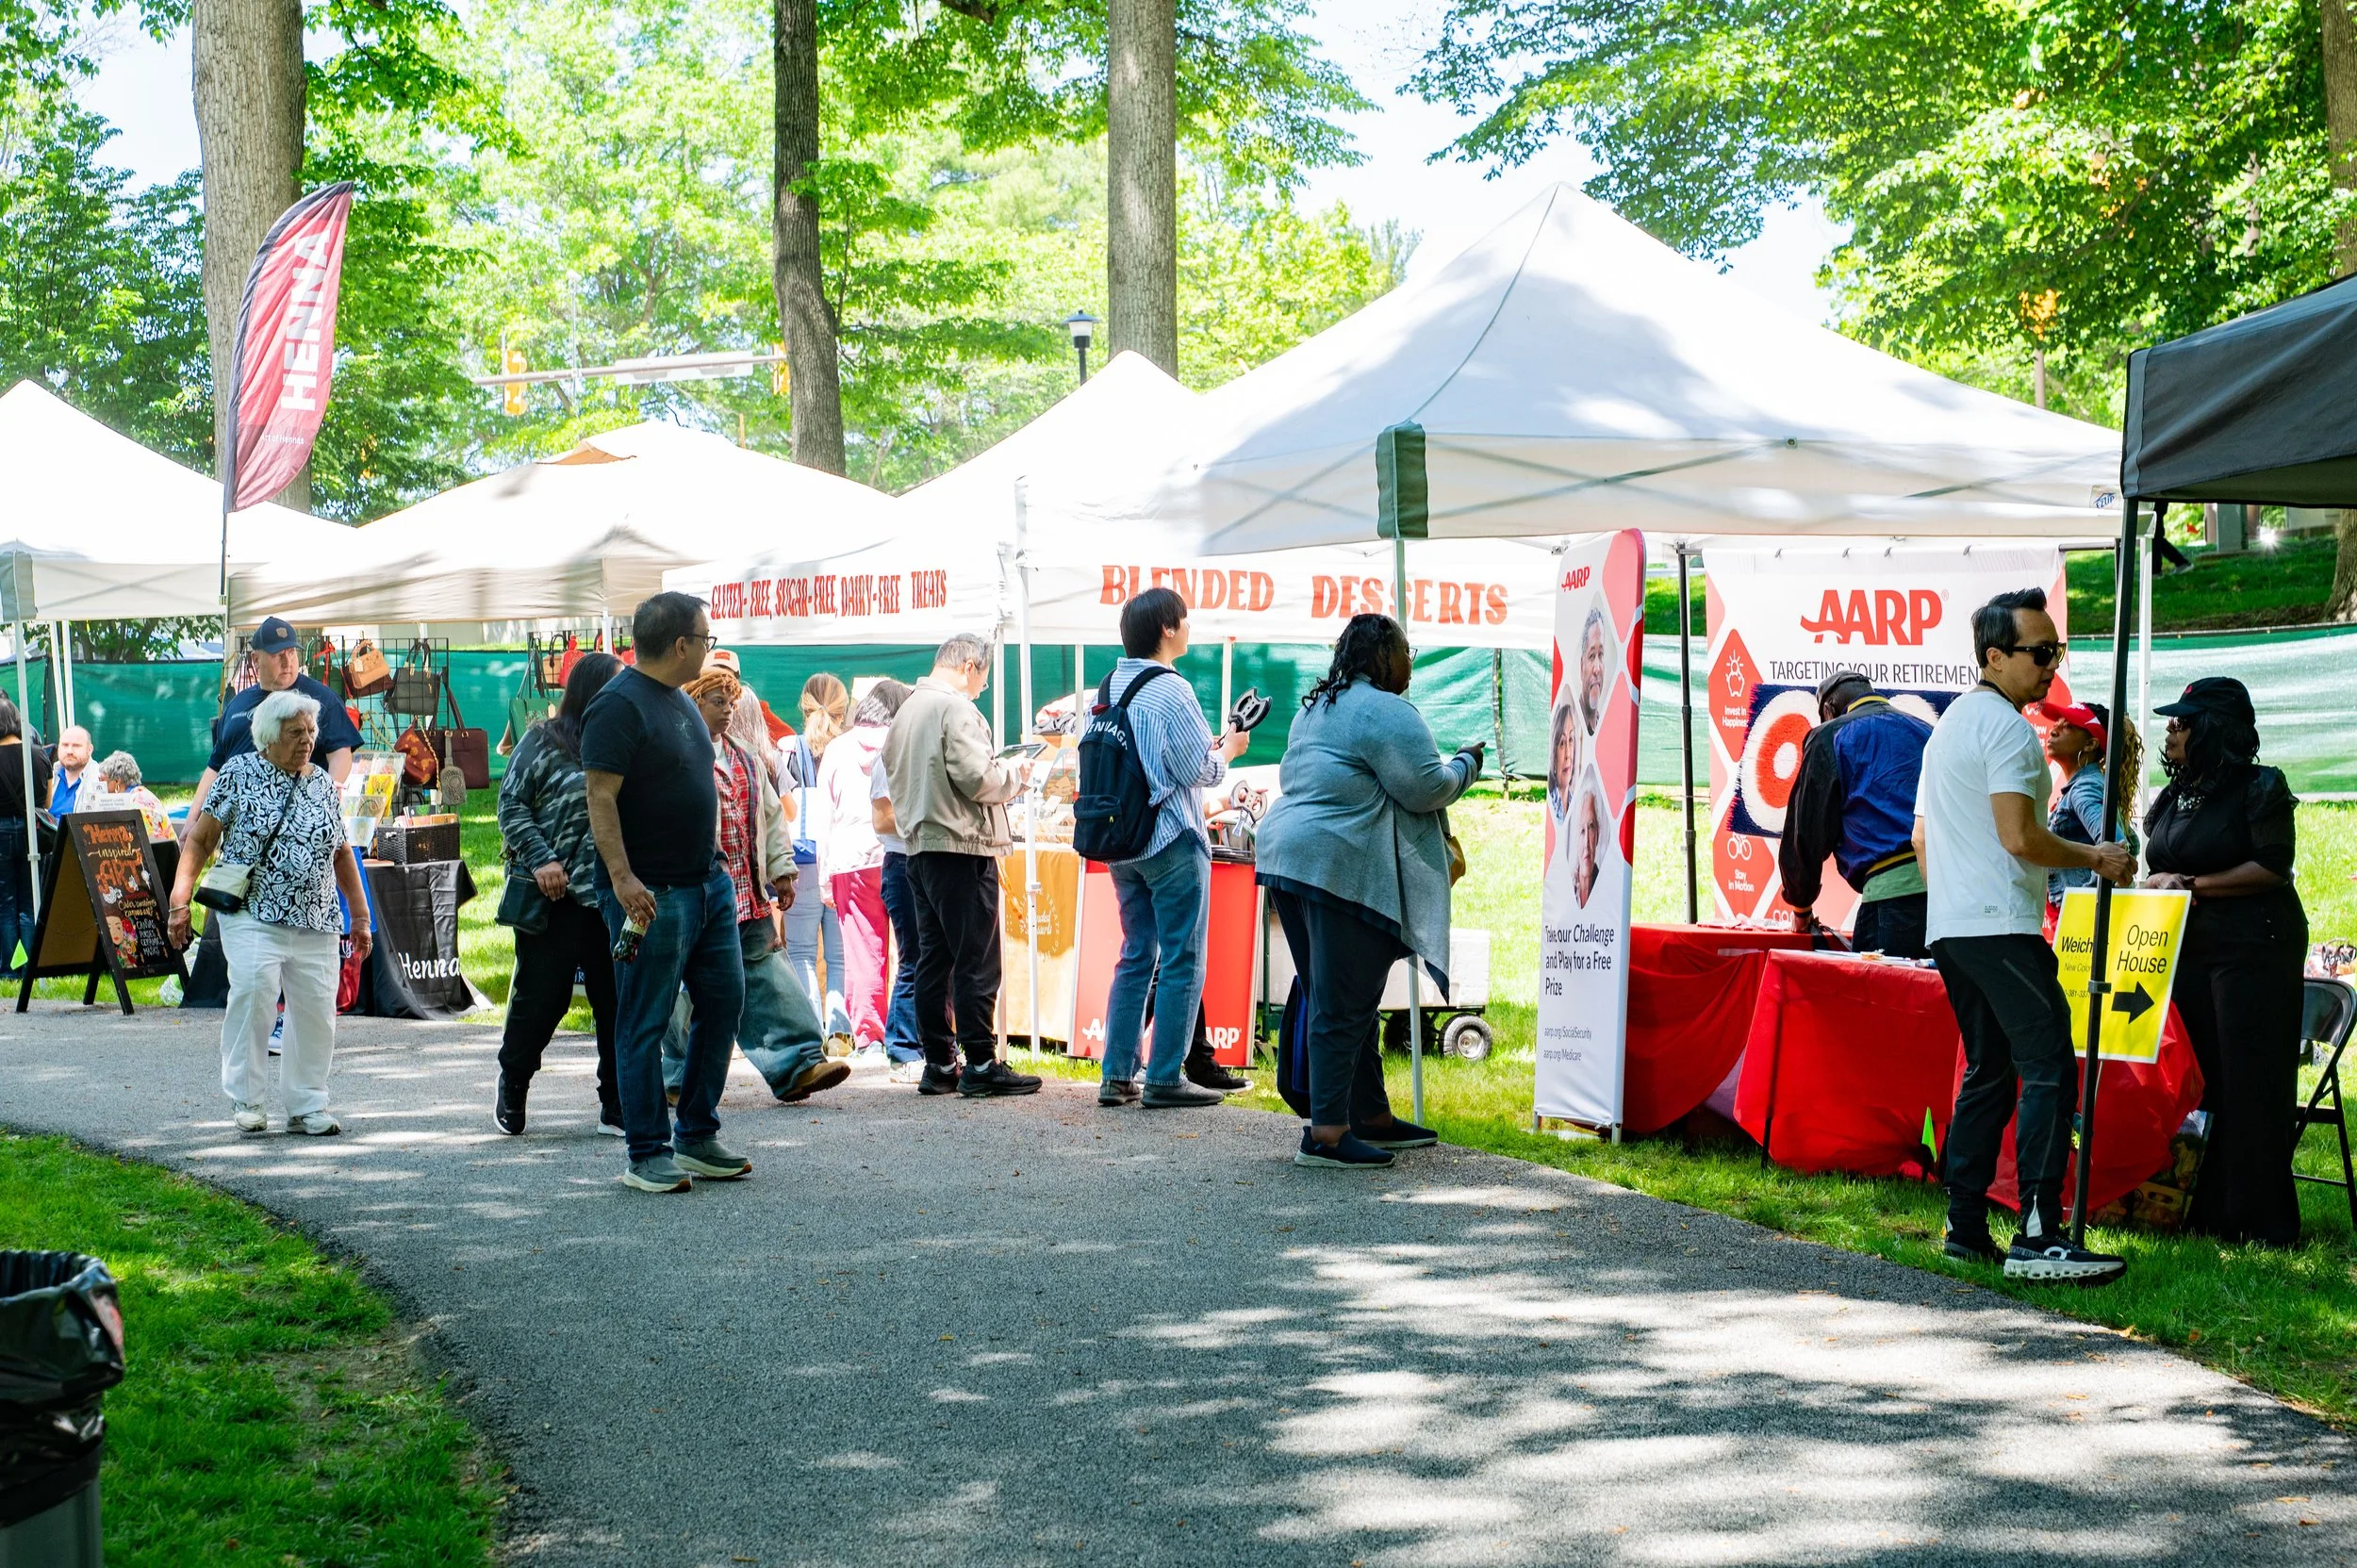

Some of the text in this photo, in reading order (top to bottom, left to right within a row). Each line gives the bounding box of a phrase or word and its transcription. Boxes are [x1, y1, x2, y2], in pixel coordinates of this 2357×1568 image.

[281, 228, 331, 411] HENNA
[1561, 566, 1591, 592] AARP
[841, 574, 901, 617] DAIRY-FREE
[911, 569, 947, 609] TREATS
[1800, 589, 1943, 645] AARP
[1893, 664, 1980, 685] RETIREMEN
[1724, 705, 1741, 716] Invest
[1722, 717, 1750, 728] Happines
[83, 824, 134, 845] Henna
[95, 851, 142, 893] ART
[1735, 868, 1747, 882] Stay
[1558, 928, 1572, 943] our
[1573, 924, 1615, 947] Challenge
[2061, 936, 2095, 953] Weich
[2127, 924, 2168, 950] Open
[398, 952, 461, 980] Henna
[1545, 950, 1612, 973] and Play for a Free
[2117, 950, 2167, 974] House
[1545, 977, 1563, 996] Prize
[1205, 1027, 1241, 1048] ARP
